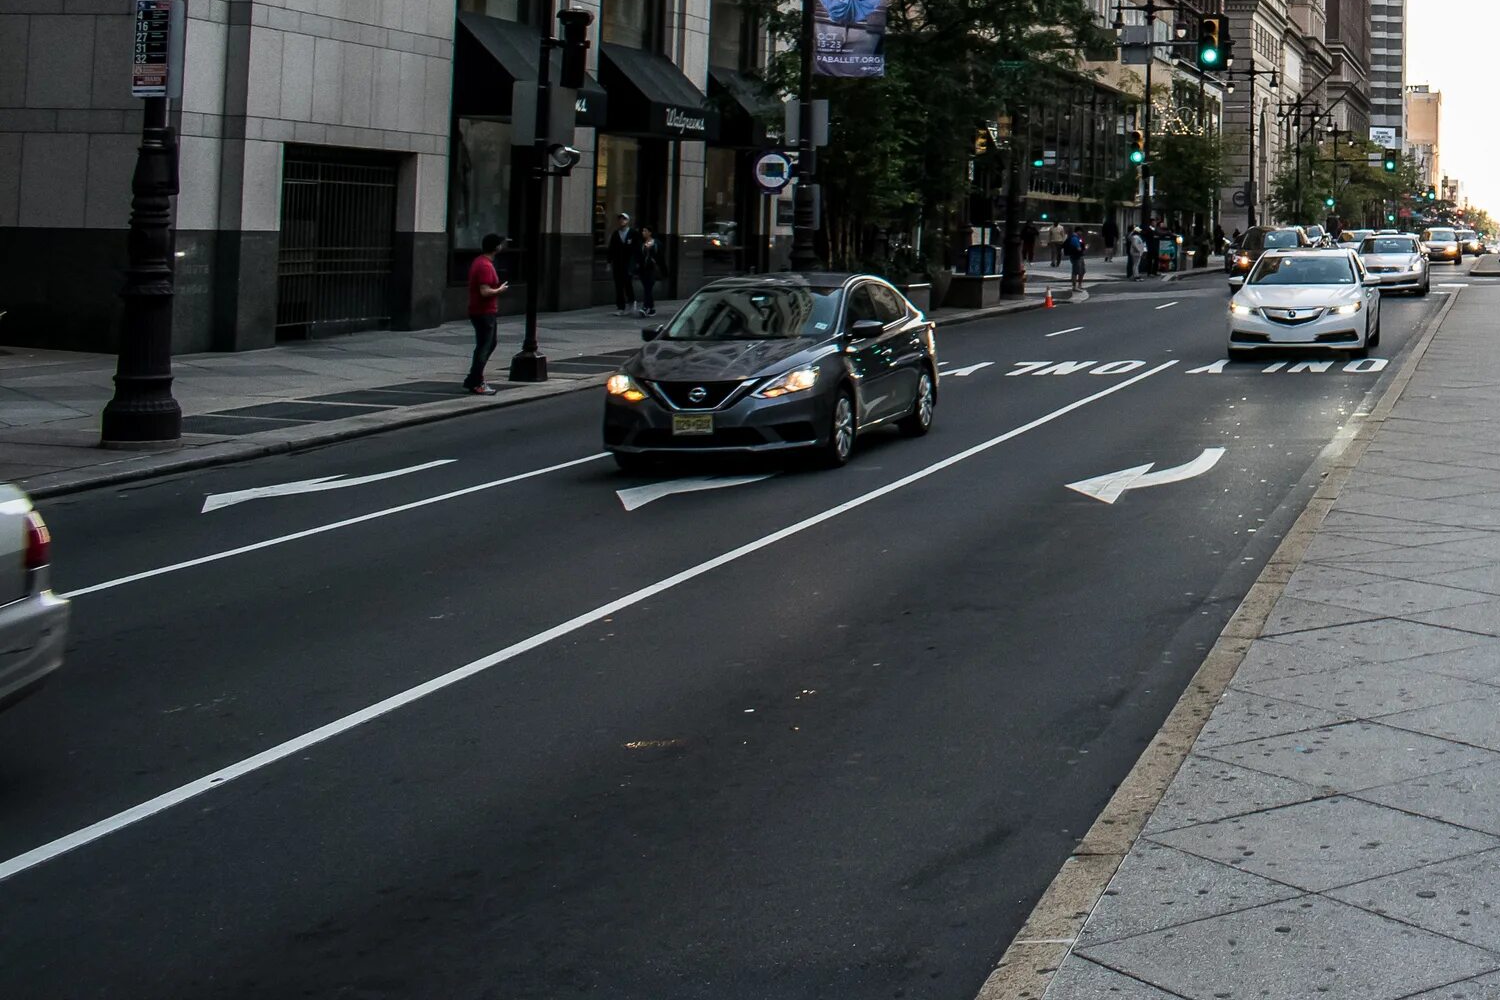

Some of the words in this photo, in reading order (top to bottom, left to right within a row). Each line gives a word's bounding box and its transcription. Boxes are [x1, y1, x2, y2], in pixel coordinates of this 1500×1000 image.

[137, 10, 143, 20] 4
[137, 21, 148, 31] 16
[136, 32, 147, 42] 27
[817, 32, 837, 40] OCT
[135, 43, 146, 53] 31
[135, 54, 147, 64] 32
[816, 55, 880, 64] PABALLET.ORG
[666, 107, 705, 134] Walgreens
[938, 360, 1147, 376] ONLY
